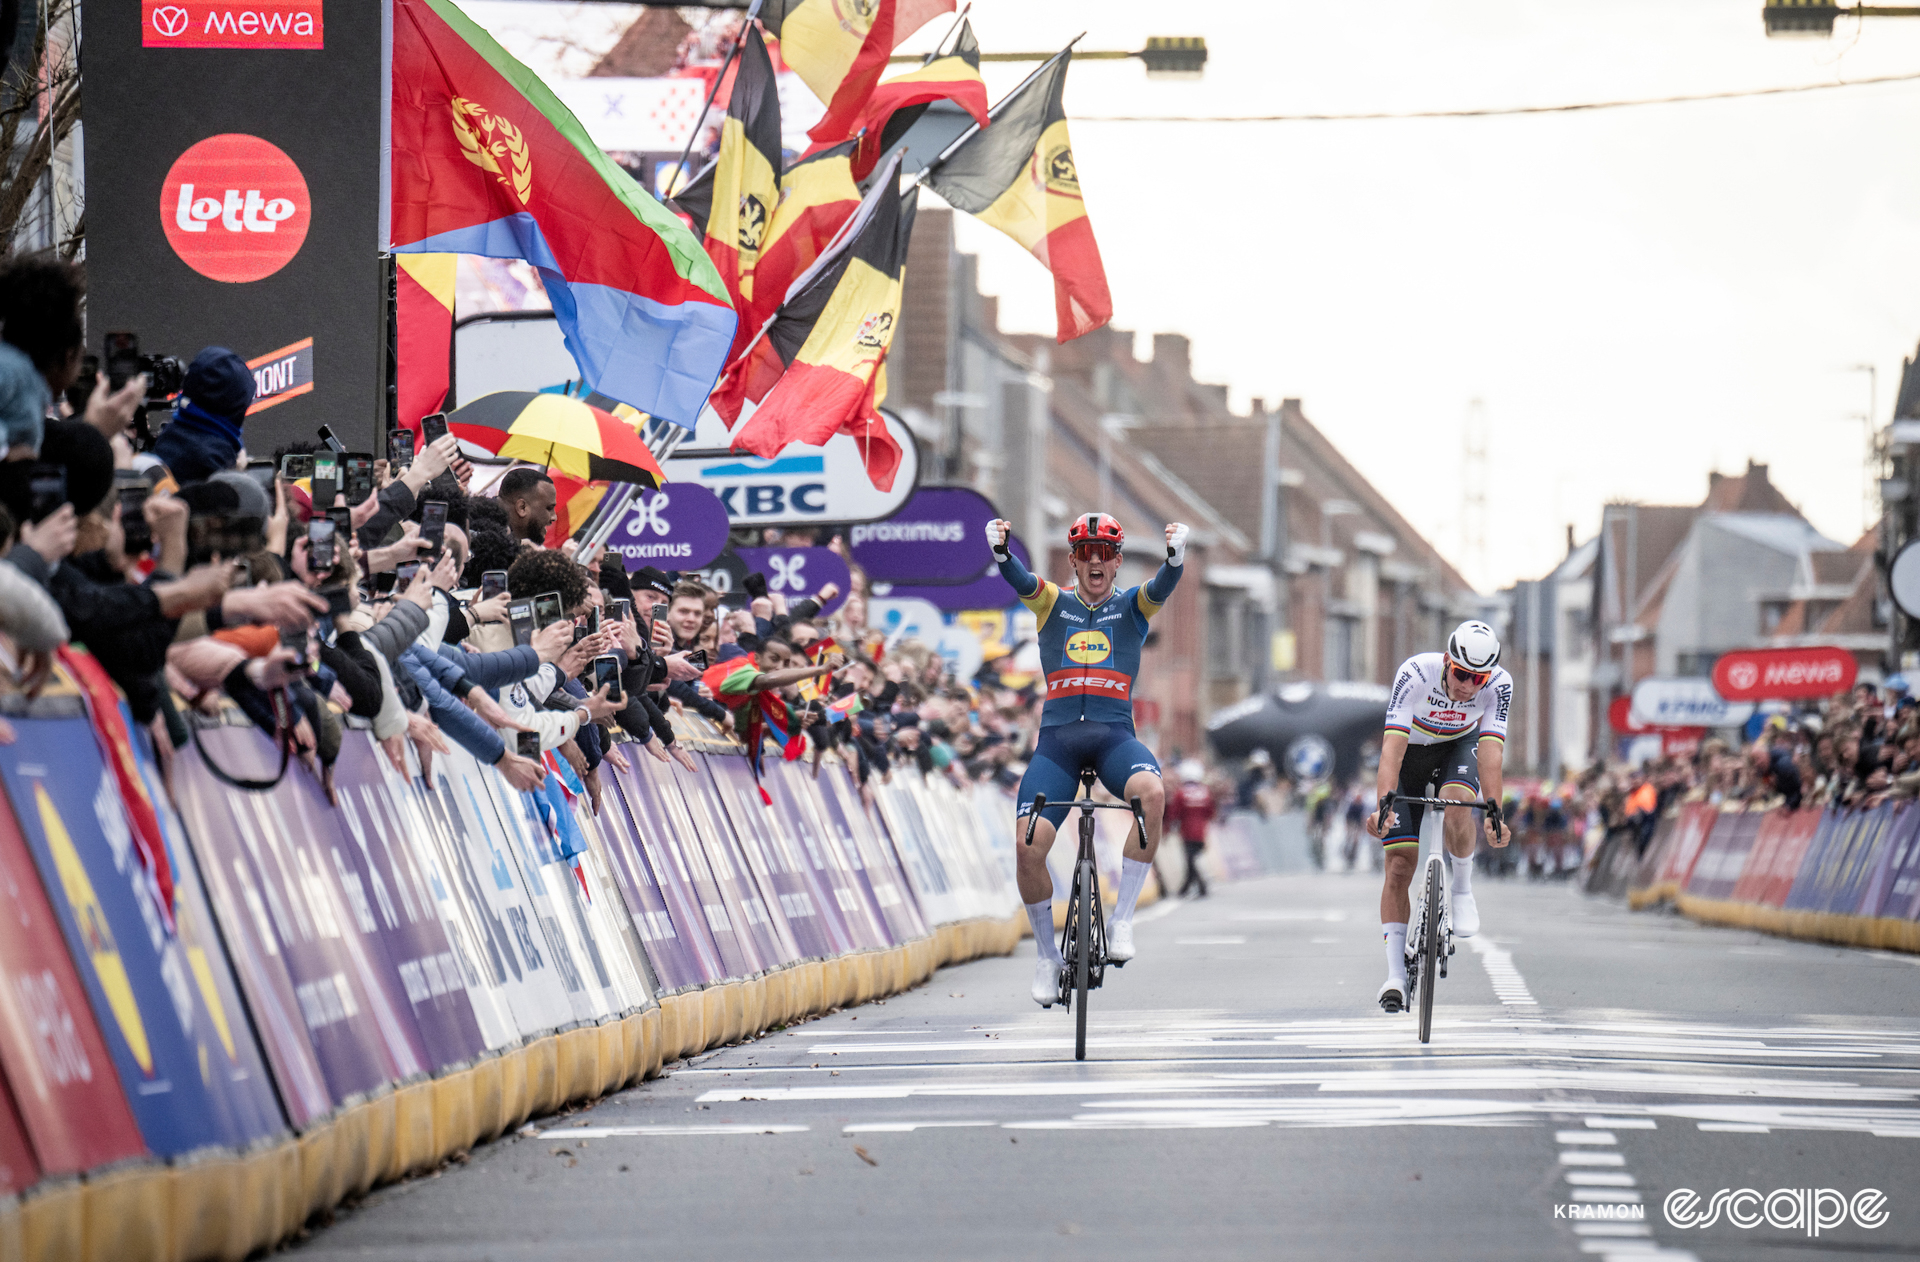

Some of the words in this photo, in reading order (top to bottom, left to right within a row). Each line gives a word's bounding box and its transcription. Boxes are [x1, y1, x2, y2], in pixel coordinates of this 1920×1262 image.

[708, 484, 825, 516] KBC
[851, 522, 964, 547] proximus
[1060, 610, 1086, 623] Santini
[1049, 676, 1127, 692] TREK
[1430, 696, 1448, 709] UCI
